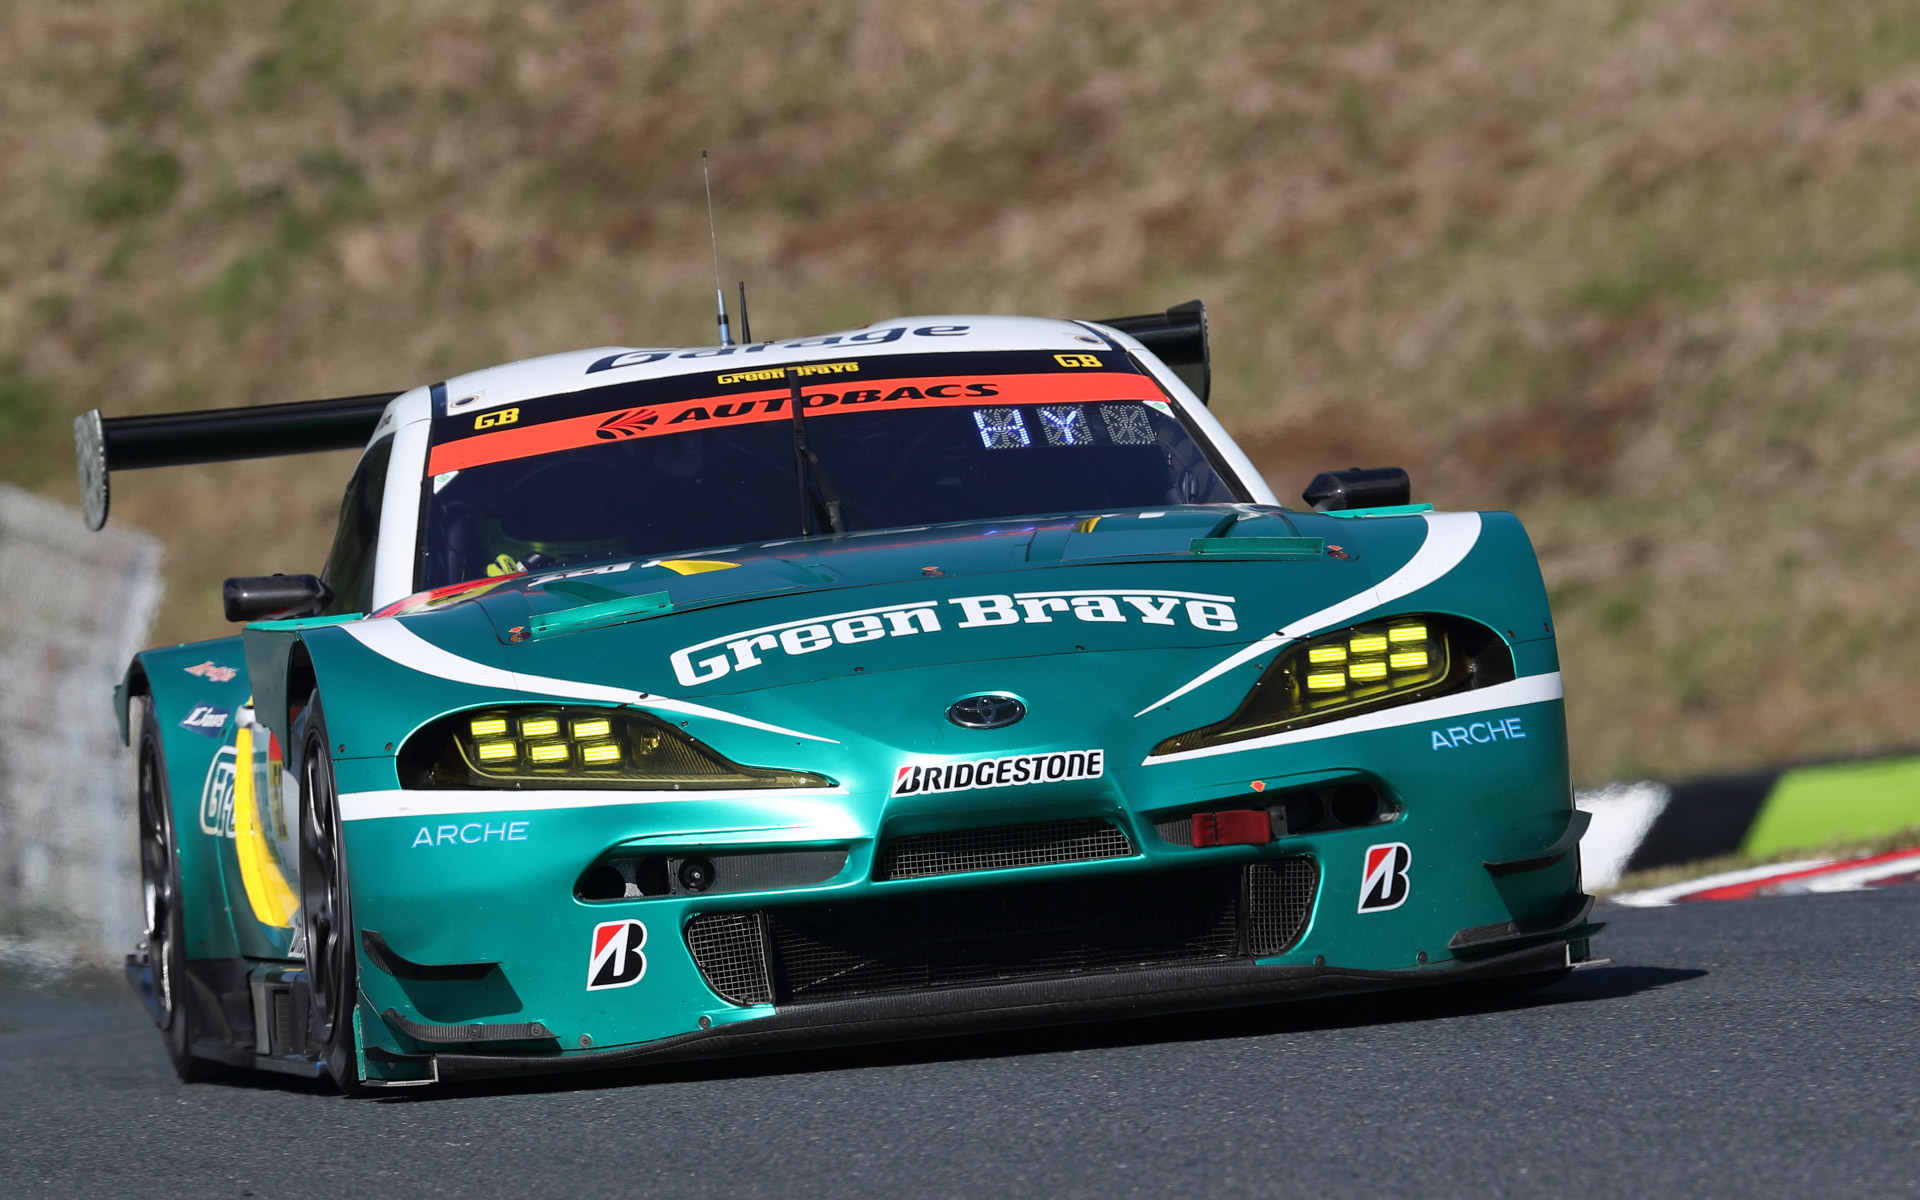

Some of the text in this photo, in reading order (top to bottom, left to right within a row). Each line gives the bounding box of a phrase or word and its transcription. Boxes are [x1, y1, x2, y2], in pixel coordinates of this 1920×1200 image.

[717, 367, 785, 385] Green
[1053, 354, 1103, 368] GB
[474, 407, 520, 430] GB
[665, 383, 1000, 426] AUTOBACS
[670, 600, 941, 687] Green
[1430, 717, 1526, 751] ARCHE
[895, 752, 1101, 794] BRIDGESTONE
[411, 821, 530, 848] ARCHE
